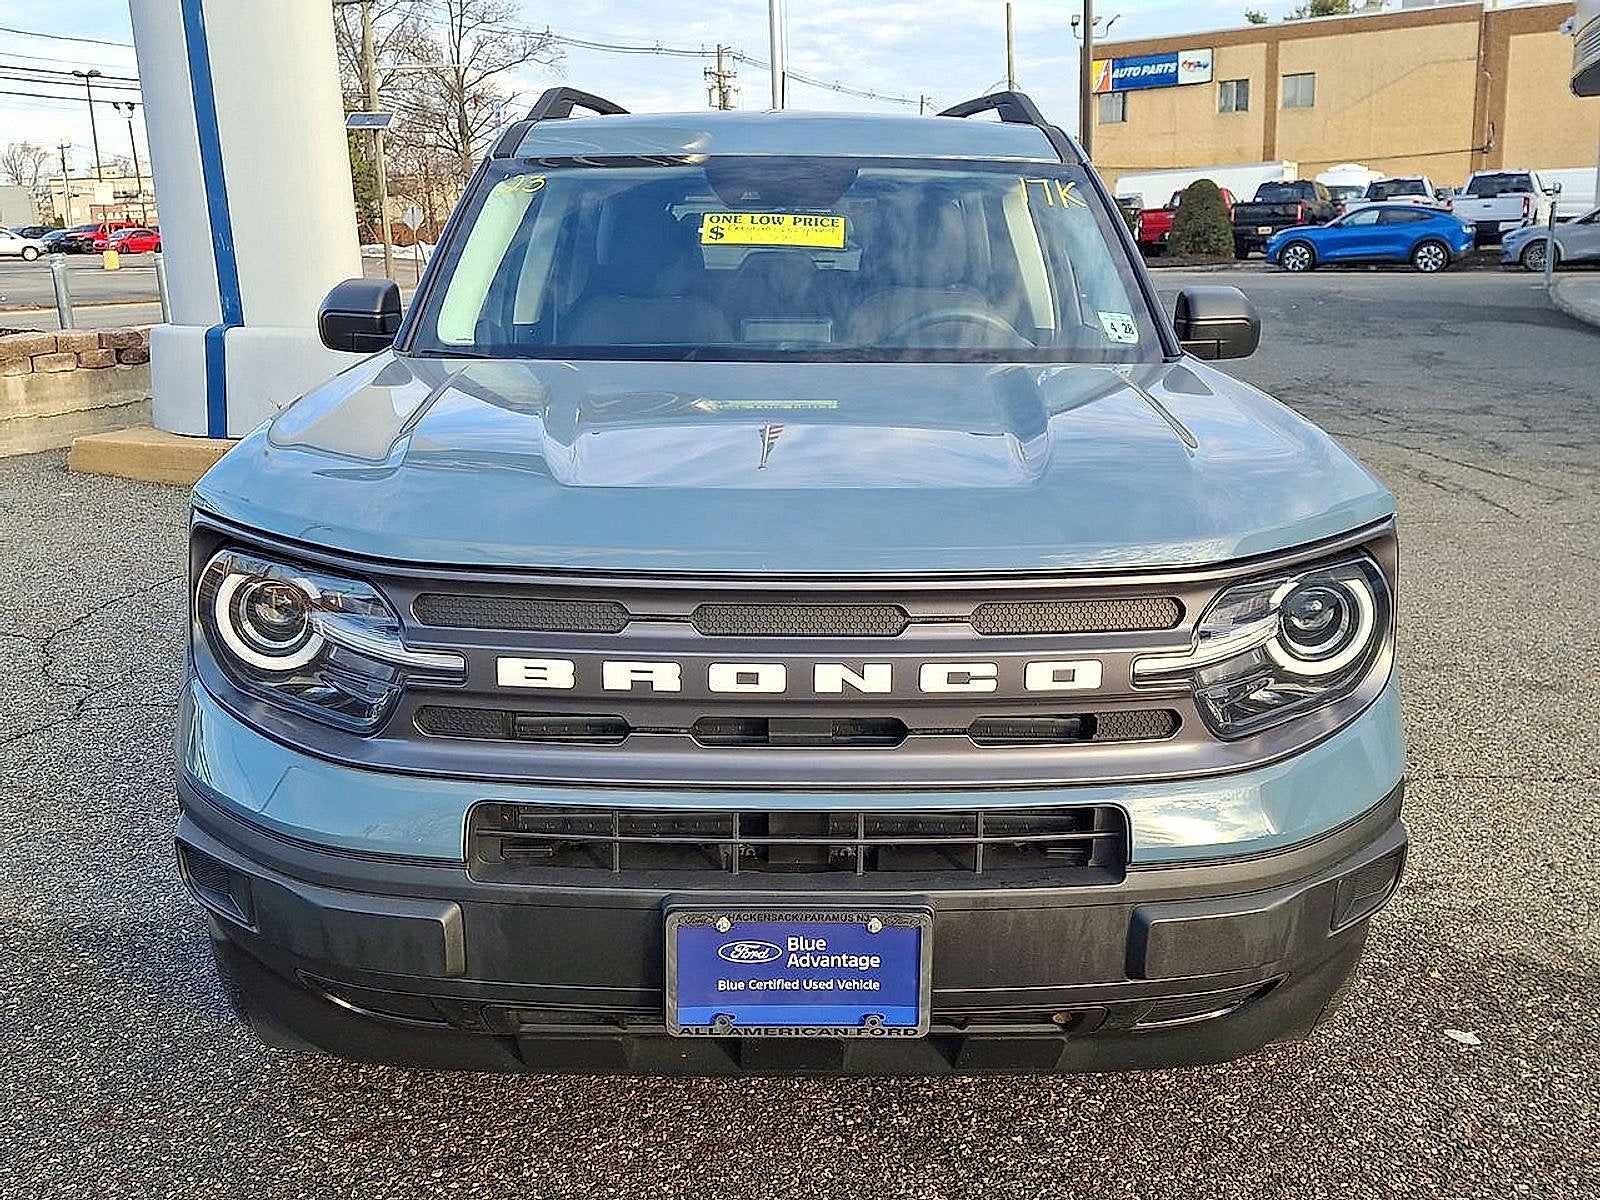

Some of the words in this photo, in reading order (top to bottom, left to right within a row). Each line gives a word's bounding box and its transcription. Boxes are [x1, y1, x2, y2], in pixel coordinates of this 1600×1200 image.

[1113, 66, 1142, 79] AUTO
[1141, 62, 1178, 75] PARTS
[1020, 177, 1088, 209] 17K
[708, 215, 742, 224] ONE
[750, 215, 785, 225] LOW
[793, 216, 840, 228] PRICE
[708, 225, 725, 241] $
[497, 656, 1103, 693] BRONCO
[730, 943, 771, 960] Ford
[787, 936, 827, 952] Blue
[786, 953, 881, 971] Advantage
[717, 979, 746, 991] Blue
[748, 979, 800, 991] Certified
[802, 979, 834, 990] Used
[836, 979, 881, 991] Vehicle
[679, 1027, 721, 1036] ALL
[727, 1027, 849, 1036] AMERICAN
[857, 1027, 919, 1037] FORD
